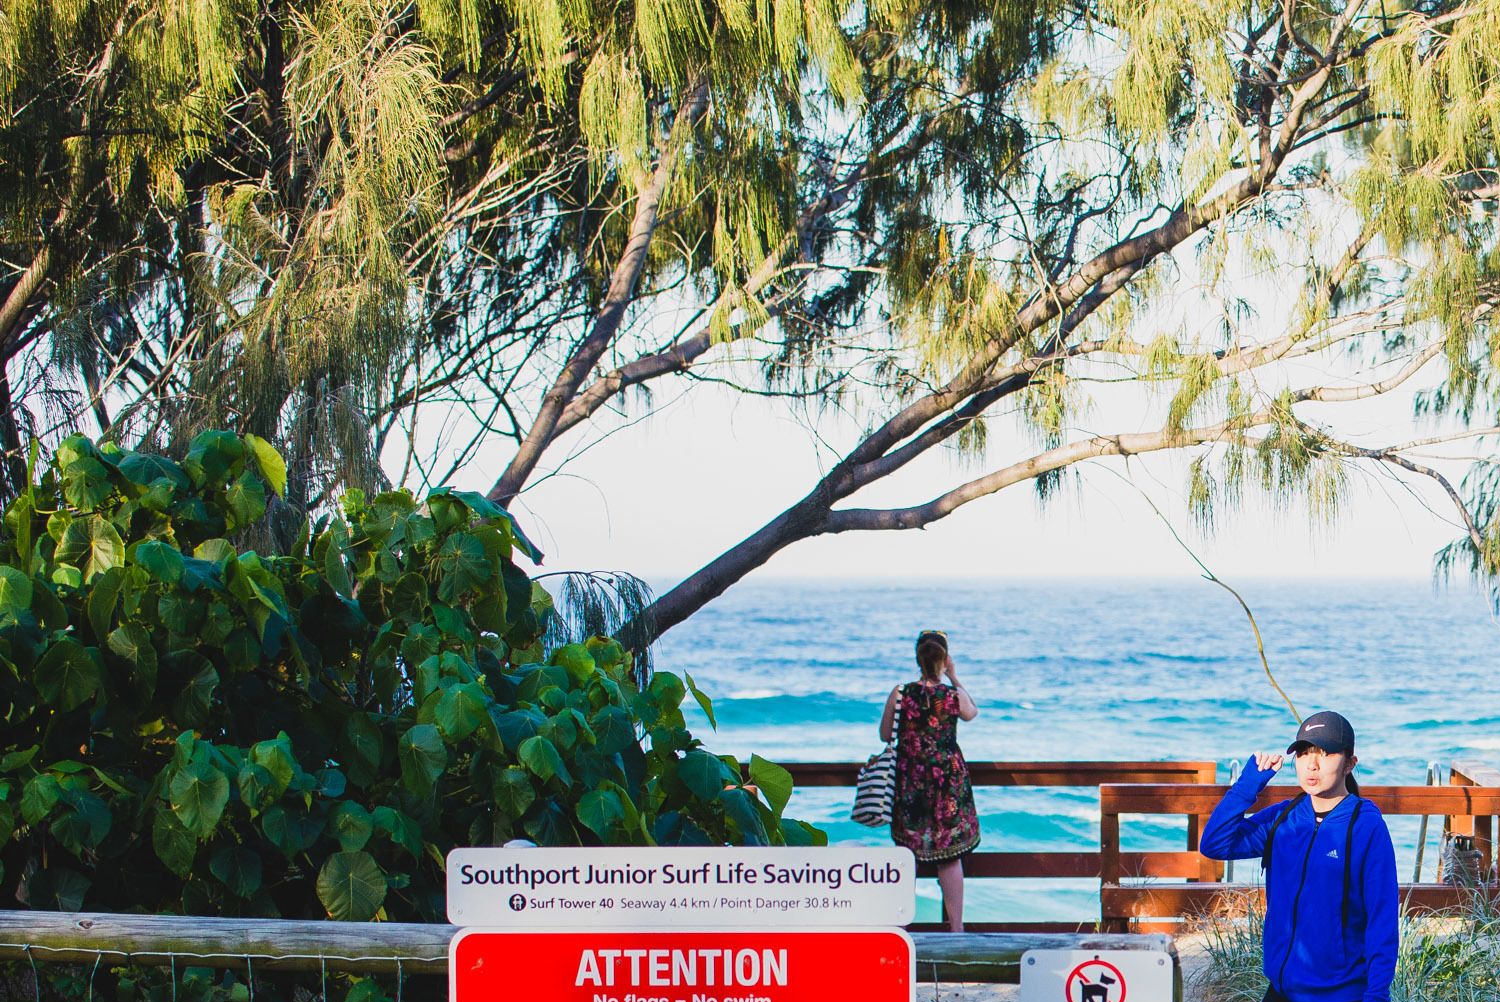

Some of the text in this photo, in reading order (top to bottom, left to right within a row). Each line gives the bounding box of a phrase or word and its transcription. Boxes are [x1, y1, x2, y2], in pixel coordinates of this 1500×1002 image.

[461, 863, 901, 889] Southport Junior Surf Life Saving Club
[530, 898, 554, 908] Surf
[559, 898, 596, 908] Tower
[599, 898, 614, 908] 40
[621, 898, 666, 911] Seaway
[669, 898, 687, 908] 4.4
[691, 898, 710, 908] km
[721, 898, 751, 908] Point
[756, 898, 800, 911] Danger
[804, 898, 829, 908] 30.8
[833, 898, 852, 908] km
[574, 948, 787, 986] ATTENTION
